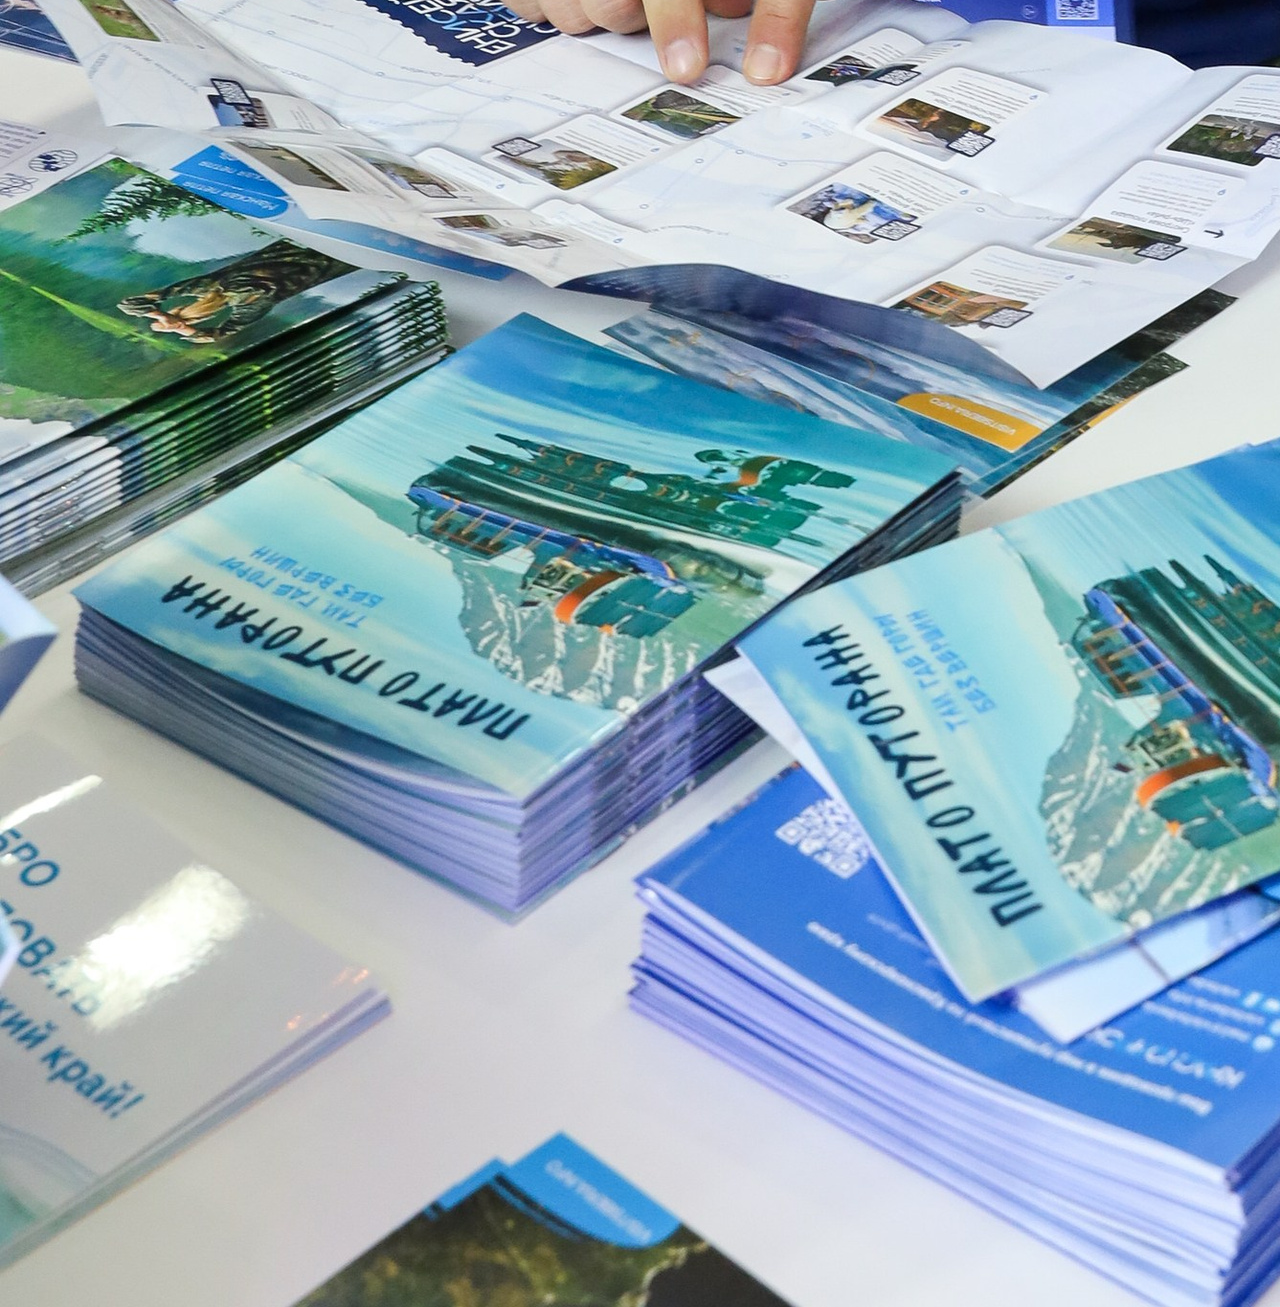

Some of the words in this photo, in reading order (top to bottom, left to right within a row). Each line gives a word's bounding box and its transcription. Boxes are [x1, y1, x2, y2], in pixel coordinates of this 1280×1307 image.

[219, 557, 277, 589] ГОРЫ
[250, 546, 338, 590] ВЕРШИН
[333, 583, 384, 608] БЕЗ
[162, 575, 385, 684] ПУТОРАНА
[873, 613, 916, 654] ГОРЫ
[906, 609, 967, 675] ВЕРШИН
[378, 668, 533, 743] ПЛАТО
[803, 623, 958, 807] ПУТОРАНА
[955, 675, 996, 714] БЕЗ
[926, 805, 1045, 928] ПЛАТО
[40, 1046, 147, 1121] край!
